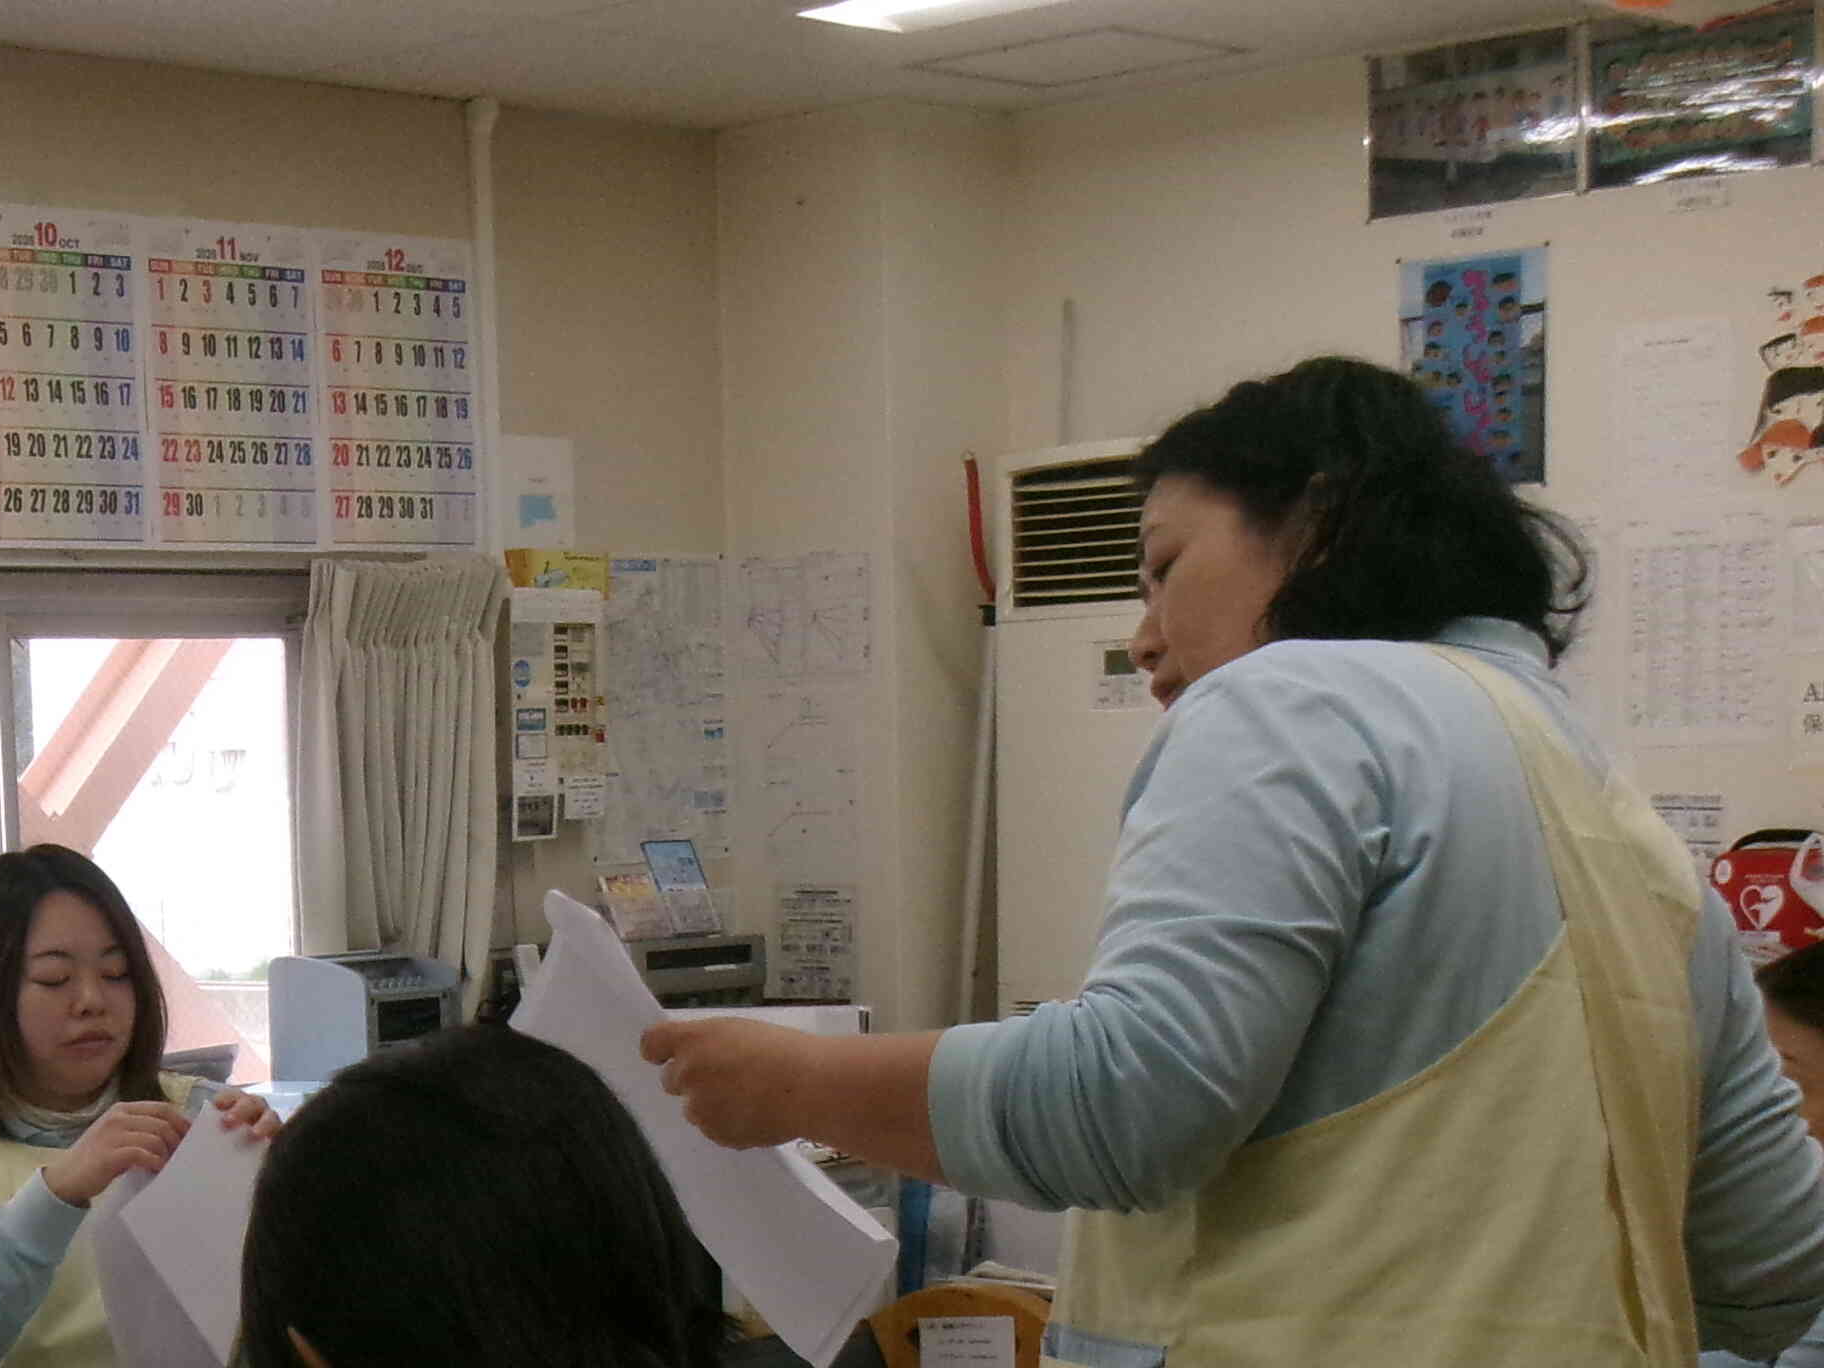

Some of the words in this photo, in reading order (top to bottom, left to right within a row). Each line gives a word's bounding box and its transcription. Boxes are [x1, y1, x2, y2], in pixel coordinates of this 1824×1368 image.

[34, 222, 57, 246] 10
[59, 238, 80, 249] OCT
[216, 236, 236, 260] 11
[384, 248, 405, 272] 12
[158, 384, 175, 409] 15
[180, 385, 197, 410] 16
[204, 386, 219, 411] 17
[225, 387, 242, 412] 18
[248, 388, 264, 413] 19
[268, 389, 287, 414] 20
[291, 390, 307, 414] 21
[331, 390, 347, 415] 13
[353, 392, 368, 415] 14
[373, 392, 389, 416] 15
[393, 394, 409, 417] 16
[415, 394, 428, 418] 17
[433, 395, 449, 419] 18
[453, 397, 469, 420] 19
[4, 431, 22, 457] 19
[26, 432, 47, 458] 20
[52, 433, 69, 459] 21
[74, 434, 93, 459] 22
[97, 434, 117, 461] 23
[121, 436, 140, 461] 24
